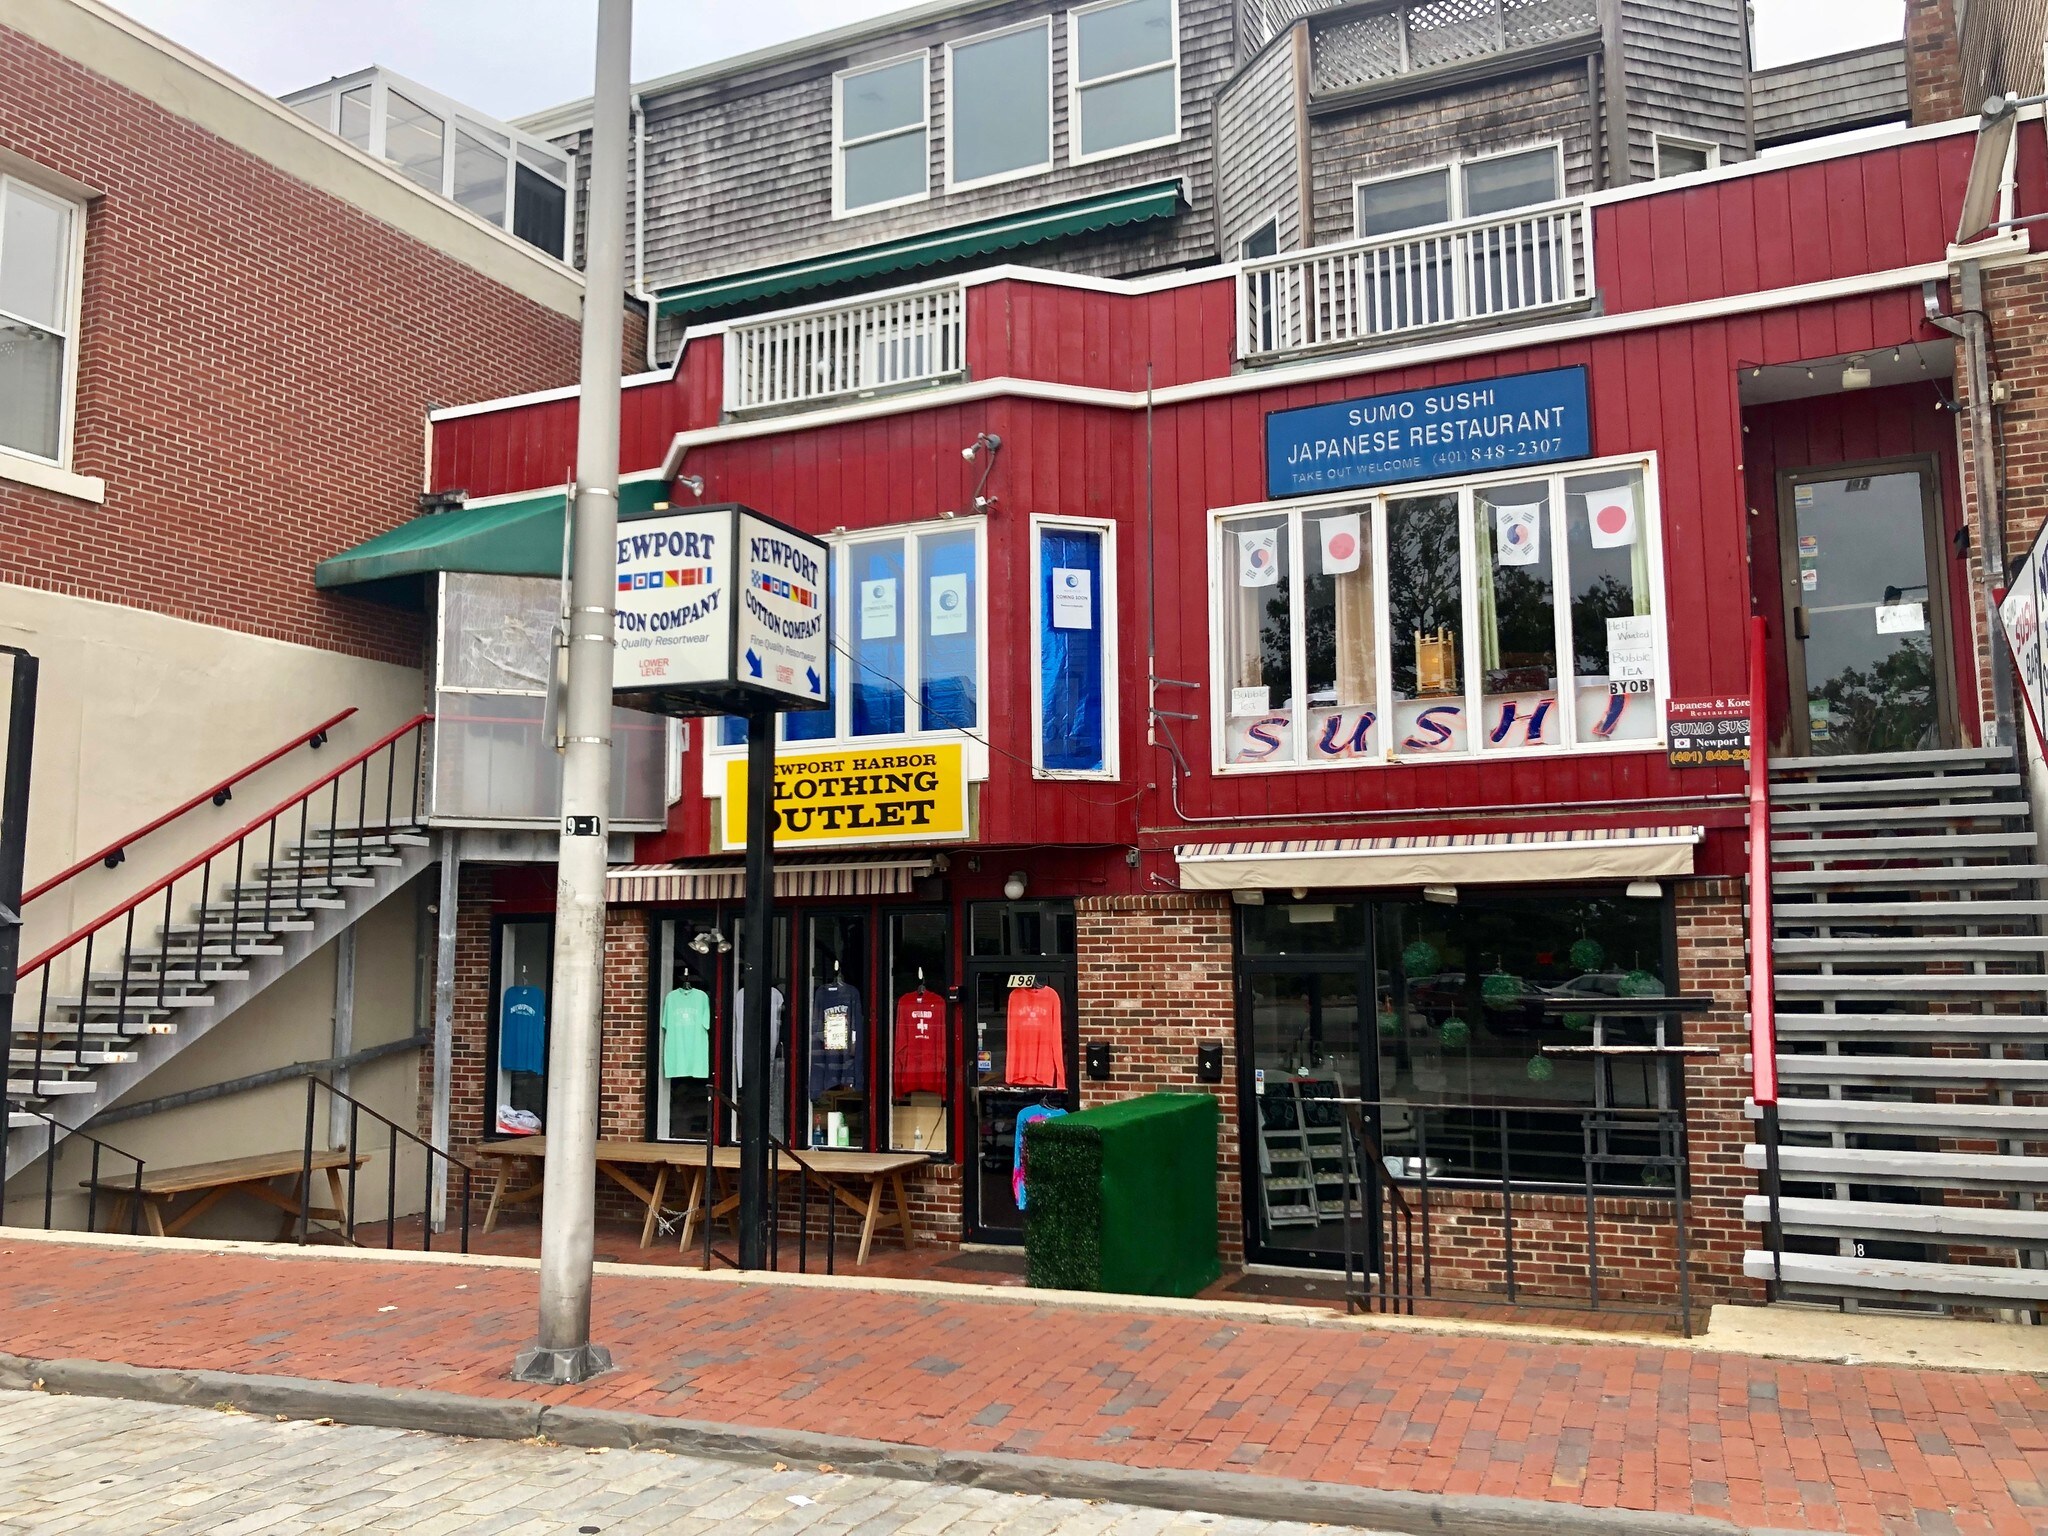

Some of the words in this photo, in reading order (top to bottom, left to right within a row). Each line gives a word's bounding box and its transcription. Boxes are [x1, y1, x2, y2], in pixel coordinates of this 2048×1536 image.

[1348, 401, 1415, 426] SUMO
[1424, 388, 1495, 415] SUSHI
[1287, 429, 1400, 465] JAPANESE
[1410, 406, 1565, 447] RESTAURANT
[1291, 469, 1322, 483] TAKE
[1327, 466, 1351, 480] OUT
[1356, 456, 1422, 475] WELCOME
[1432, 449, 1467, 467] (401)
[1471, 437, 1562, 462] 848-2307
[617, 531, 715, 565] EWPORT
[750, 537, 819, 586] NEWPORT
[616, 609, 647, 632] TON
[650, 588, 722, 632] COMPANY
[745, 588, 781, 636] COTTON
[782, 613, 822, 640] COMPANY
[1608, 620, 1632, 632] Help
[1617, 630, 1650, 641] Wanted
[621, 637, 653, 651] Quality
[656, 634, 710, 646] Resortwear
[750, 634, 764, 647] Fine
[764, 638, 786, 656] Quality
[638, 658, 670, 668] LOWER
[640, 667, 667, 677] LEVEL
[1609, 680, 1649, 695] BYOB
[1670, 701, 1713, 712] Japanese
[1715, 699, 1724, 708] &
[1727, 697, 1750, 708] Kore
[1690, 709, 1743, 717] Restaurant
[1236, 692, 1629, 763] SUSHI
[1670, 721, 1715, 737] SUMO
[1717, 719, 1750, 735] SUS
[1696, 737, 1738, 749] Newport
[774, 760, 845, 776] WPORT
[852, 753, 937, 771] HARBOR
[1670, 751, 1703, 765] (401)
[1705, 748, 1751, 761] 848-23
[774, 771, 939, 800] LOTHING
[774, 800, 935, 833] UTLET
[1009, 975, 1034, 987] 198
